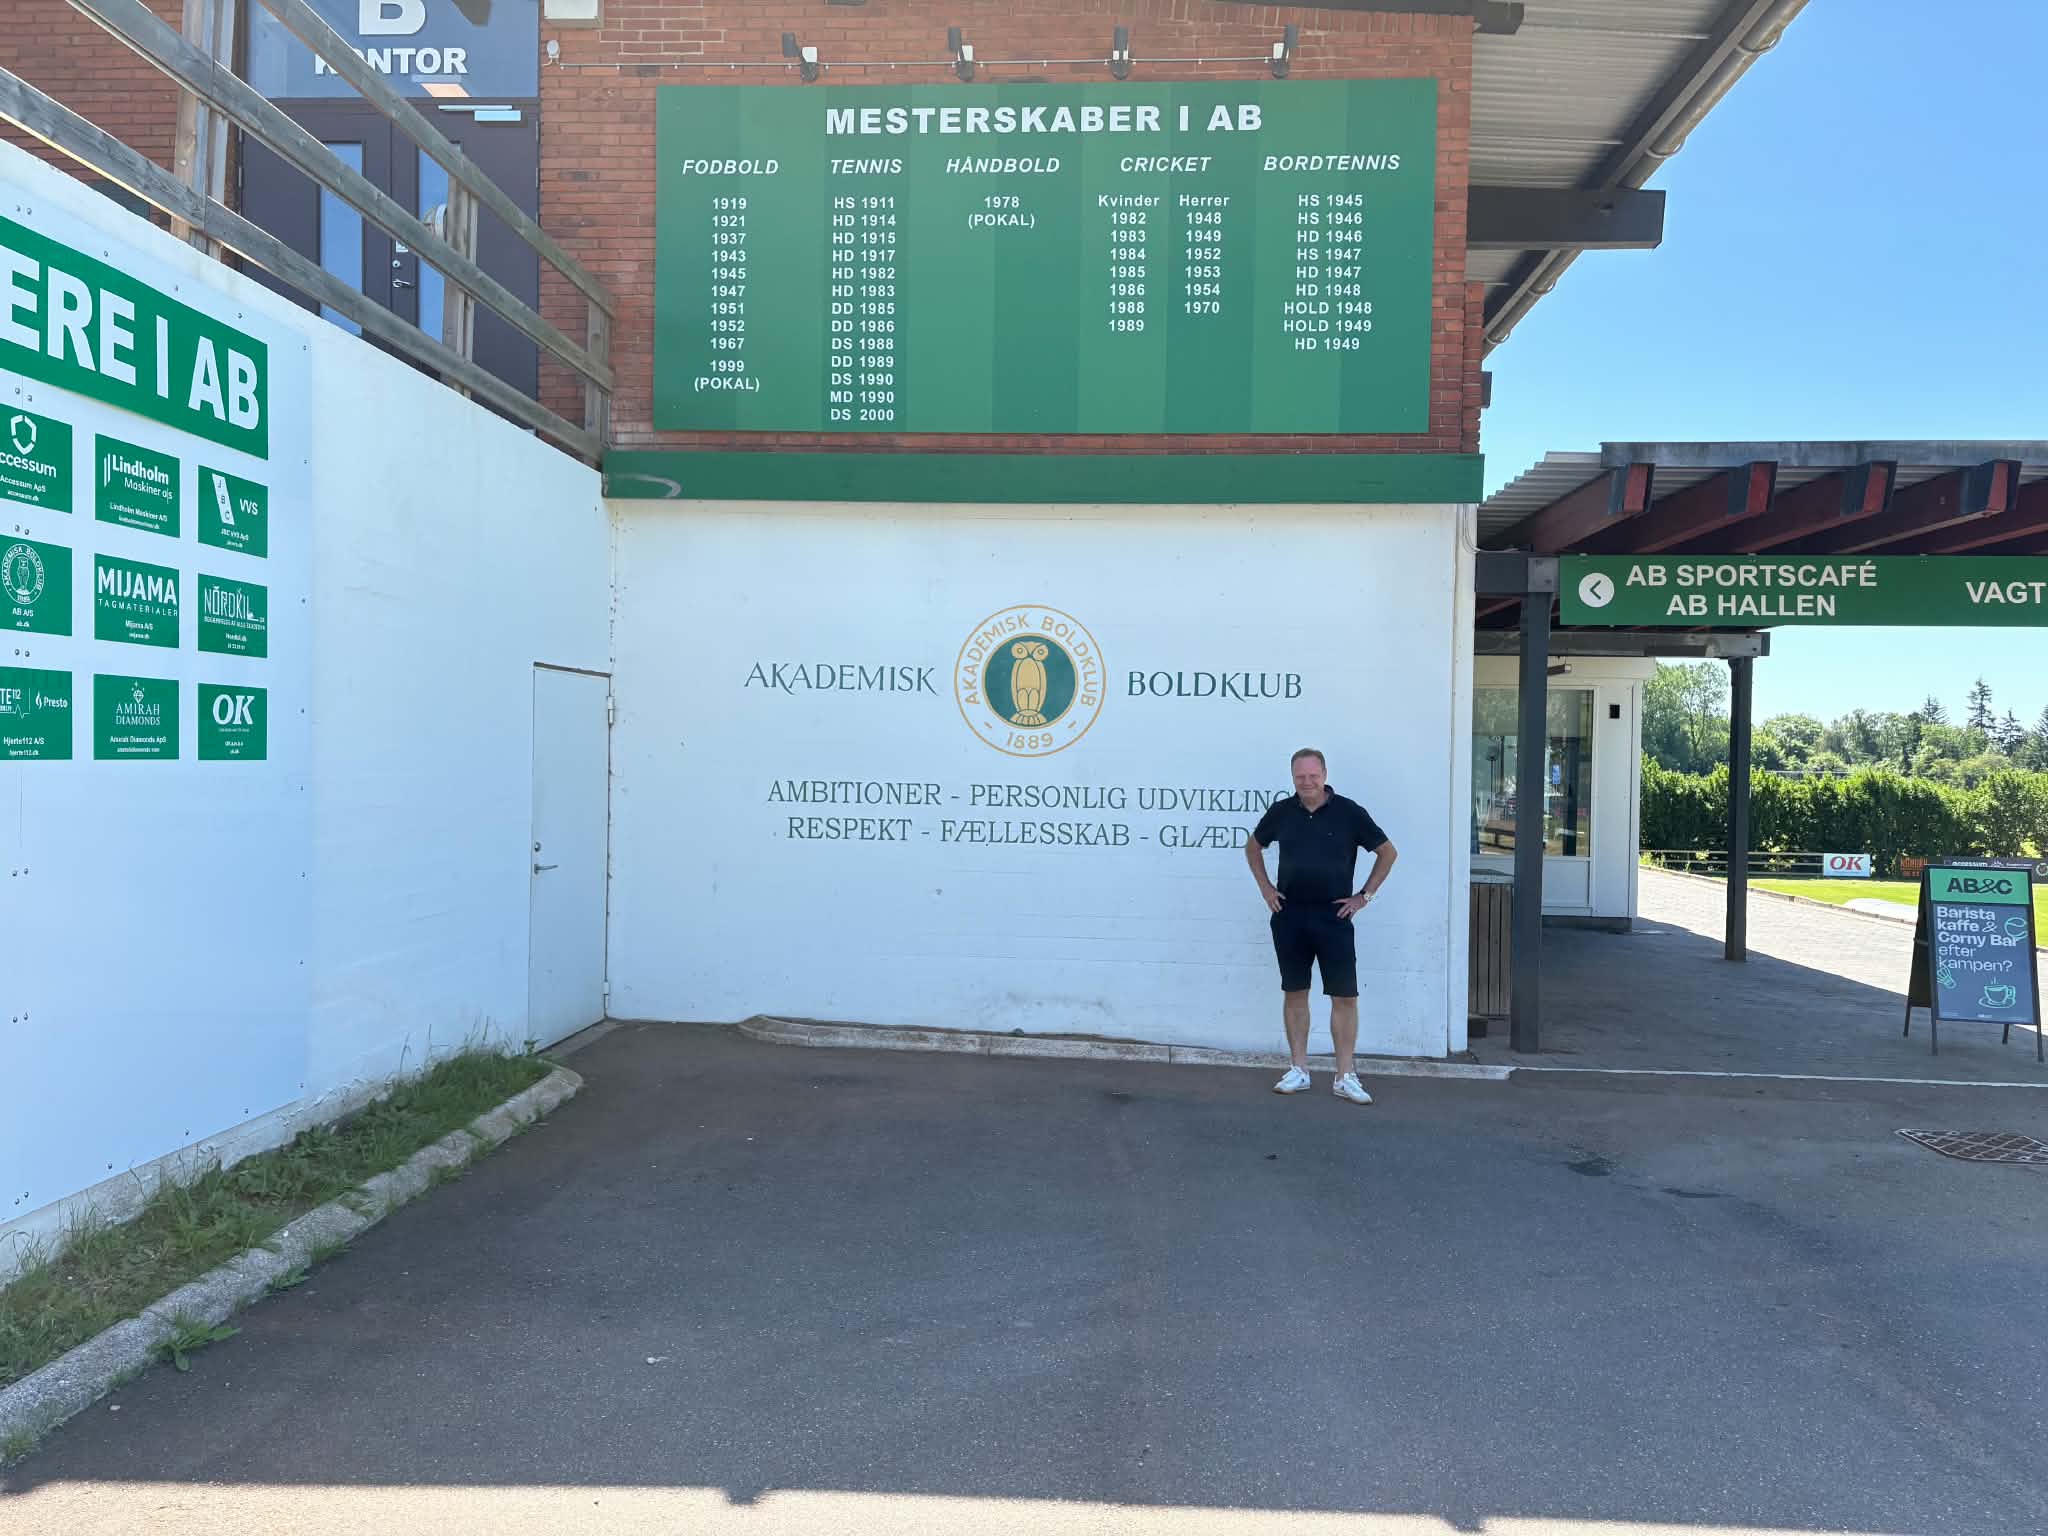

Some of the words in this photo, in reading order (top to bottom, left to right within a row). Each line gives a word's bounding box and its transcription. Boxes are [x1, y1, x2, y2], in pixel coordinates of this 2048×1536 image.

[826, 105, 1161, 135] MESTERSKABER
[1179, 105, 1189, 132] I
[1206, 104, 1262, 132] AB
[682, 159, 779, 175] FODBOLD
[830, 158, 903, 175] TENNIS
[946, 155, 1060, 174] HÅNDBOLD
[1120, 156, 1213, 173] CRICKET
[1263, 154, 1401, 171] BORDTENNIS
[712, 197, 747, 210] 1919
[834, 196, 856, 209] HS
[861, 196, 894, 209] 1911
[984, 195, 1020, 209] 1978
[1098, 194, 1160, 207] Kvinder
[1179, 194, 1231, 207] Herrer
[1298, 193, 1321, 207] HS
[1326, 193, 1363, 207] 1945
[712, 215, 745, 227] 1921
[832, 214, 855, 227] HD
[860, 214, 897, 227] 1914
[968, 213, 1035, 230] (POKAL)
[1111, 211, 1147, 225] 1982
[1186, 211, 1222, 225] 1948
[1297, 211, 1320, 225] HS
[1325, 211, 1363, 225] 1946
[711, 232, 747, 245] 1937
[832, 231, 855, 245] HD
[860, 231, 896, 245] 1915
[1110, 229, 1146, 243] 1983
[1185, 229, 1222, 243] 1949
[1296, 229, 1320, 243] HD
[1325, 229, 1363, 243] 1946
[711, 249, 747, 263] 1943
[832, 249, 855, 262] HD
[860, 249, 896, 262] 1917
[1110, 247, 1147, 261] 1984
[1185, 247, 1222, 261] 1952
[1296, 247, 1320, 261] HS
[1325, 247, 1362, 261] 1947
[711, 267, 747, 280] 1945
[832, 266, 854, 280] HD
[860, 266, 896, 280] 1982
[1109, 265, 1146, 279] 1985
[1184, 265, 1221, 279] 1953
[1296, 265, 1319, 279] HD
[1325, 265, 1362, 279] 1947
[711, 284, 746, 297] 1947
[832, 284, 854, 297] HD
[859, 284, 896, 297] 1983
[1109, 283, 1145, 297] 1986
[1184, 282, 1221, 297] 1954
[1295, 283, 1319, 297] HD
[1325, 283, 1361, 297] 1948
[711, 302, 744, 315] 1951
[831, 302, 854, 315] DD
[859, 302, 895, 315] 1985
[1109, 301, 1145, 314] 1988
[1184, 300, 1220, 314] 1970
[1284, 301, 1330, 315] HOLD
[1335, 301, 1373, 315] 1948
[710, 319, 745, 332] 1952
[831, 319, 854, 333] DD
[859, 319, 895, 333] 1986
[1108, 319, 1145, 332] 1989
[1283, 319, 1329, 333] HOLD
[1335, 319, 1372, 333] 1949
[710, 337, 745, 350] 1967
[831, 337, 853, 351] DS
[858, 337, 894, 351] 1988
[1294, 337, 1318, 351] HD
[1323, 337, 1360, 351] 1949
[709, 359, 745, 373] 1999
[831, 355, 853, 368] DD
[859, 355, 894, 368] 1989
[156, 314, 169, 400] I
[188, 335, 260, 430] AB
[831, 372, 853, 386] DS
[858, 372, 894, 386] 1990
[694, 376, 760, 393] (POKAL)
[830, 390, 854, 404] MD
[859, 390, 895, 404] 1990
[830, 407, 852, 421] DS
[859, 408, 895, 421] 2000
[112, 454, 169, 485] Lindholm
[124, 477, 161, 496] Maskiner
[240, 498, 259, 515] VVS
[1626, 565, 1668, 587] AB
[1676, 560, 1878, 587] SPORTSCAFÉ
[98, 566, 178, 606] MIJAMA
[1966, 581, 2046, 604] VAGT
[98, 598, 178, 617] TAGMATERIALER
[1666, 594, 1709, 617] AB
[1717, 594, 1837, 617] HALLEN
[962, 613, 1031, 706] AKADEMISK
[1040, 614, 1098, 707] BOLDKLUB
[744, 661, 939, 696] AKADEMISK
[1127, 671, 1303, 703] BOLDKLUB
[44, 696, 68, 708] Presto
[116, 702, 160, 716] AMIRAH
[212, 694, 255, 725] OK
[116, 716, 161, 726] DIAMONDS
[1006, 731, 1054, 749] 1889
[768, 780, 943, 805] AMBITIONER
[969, 784, 1128, 809] PERSONLIG
[787, 817, 913, 841] RESPEKT
[940, 819, 1130, 846] FÆLLESSKAB
[1159, 825, 1250, 849] GLÆD
[1830, 855, 1864, 871] OK
[1947, 877, 2013, 895] AB&C
[1937, 906, 1995, 921] Barista
[1937, 918, 1979, 932] kaffe
[1982, 921, 1998, 933] &
[1938, 931, 1986, 947] Corny
[1990, 934, 2016, 947] Bar
[1938, 944, 1976, 957] efter
[1939, 956, 2013, 972] kampen?
